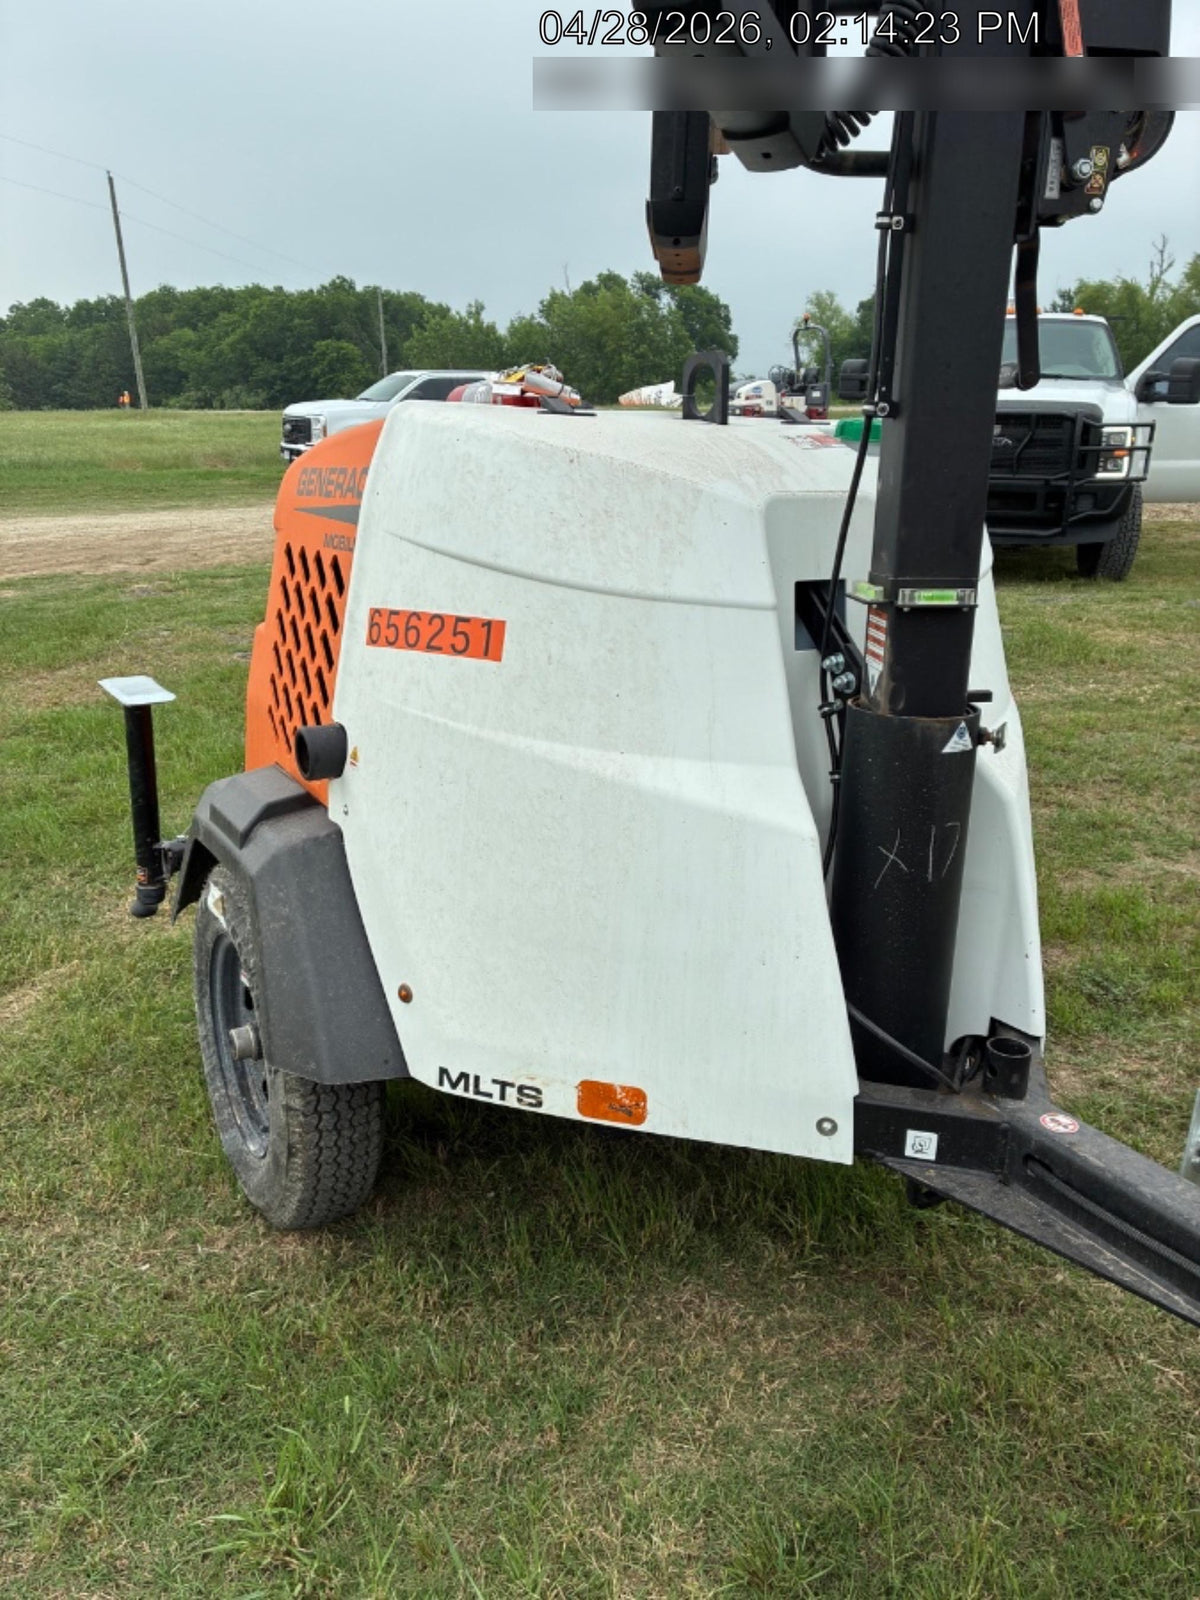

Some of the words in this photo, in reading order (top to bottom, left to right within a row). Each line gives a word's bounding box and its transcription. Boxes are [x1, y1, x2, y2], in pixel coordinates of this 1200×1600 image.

[323, 533, 356, 552] MOBIL
[368, 609, 493, 657] 656251
[438, 1066, 544, 1108] MLTS
